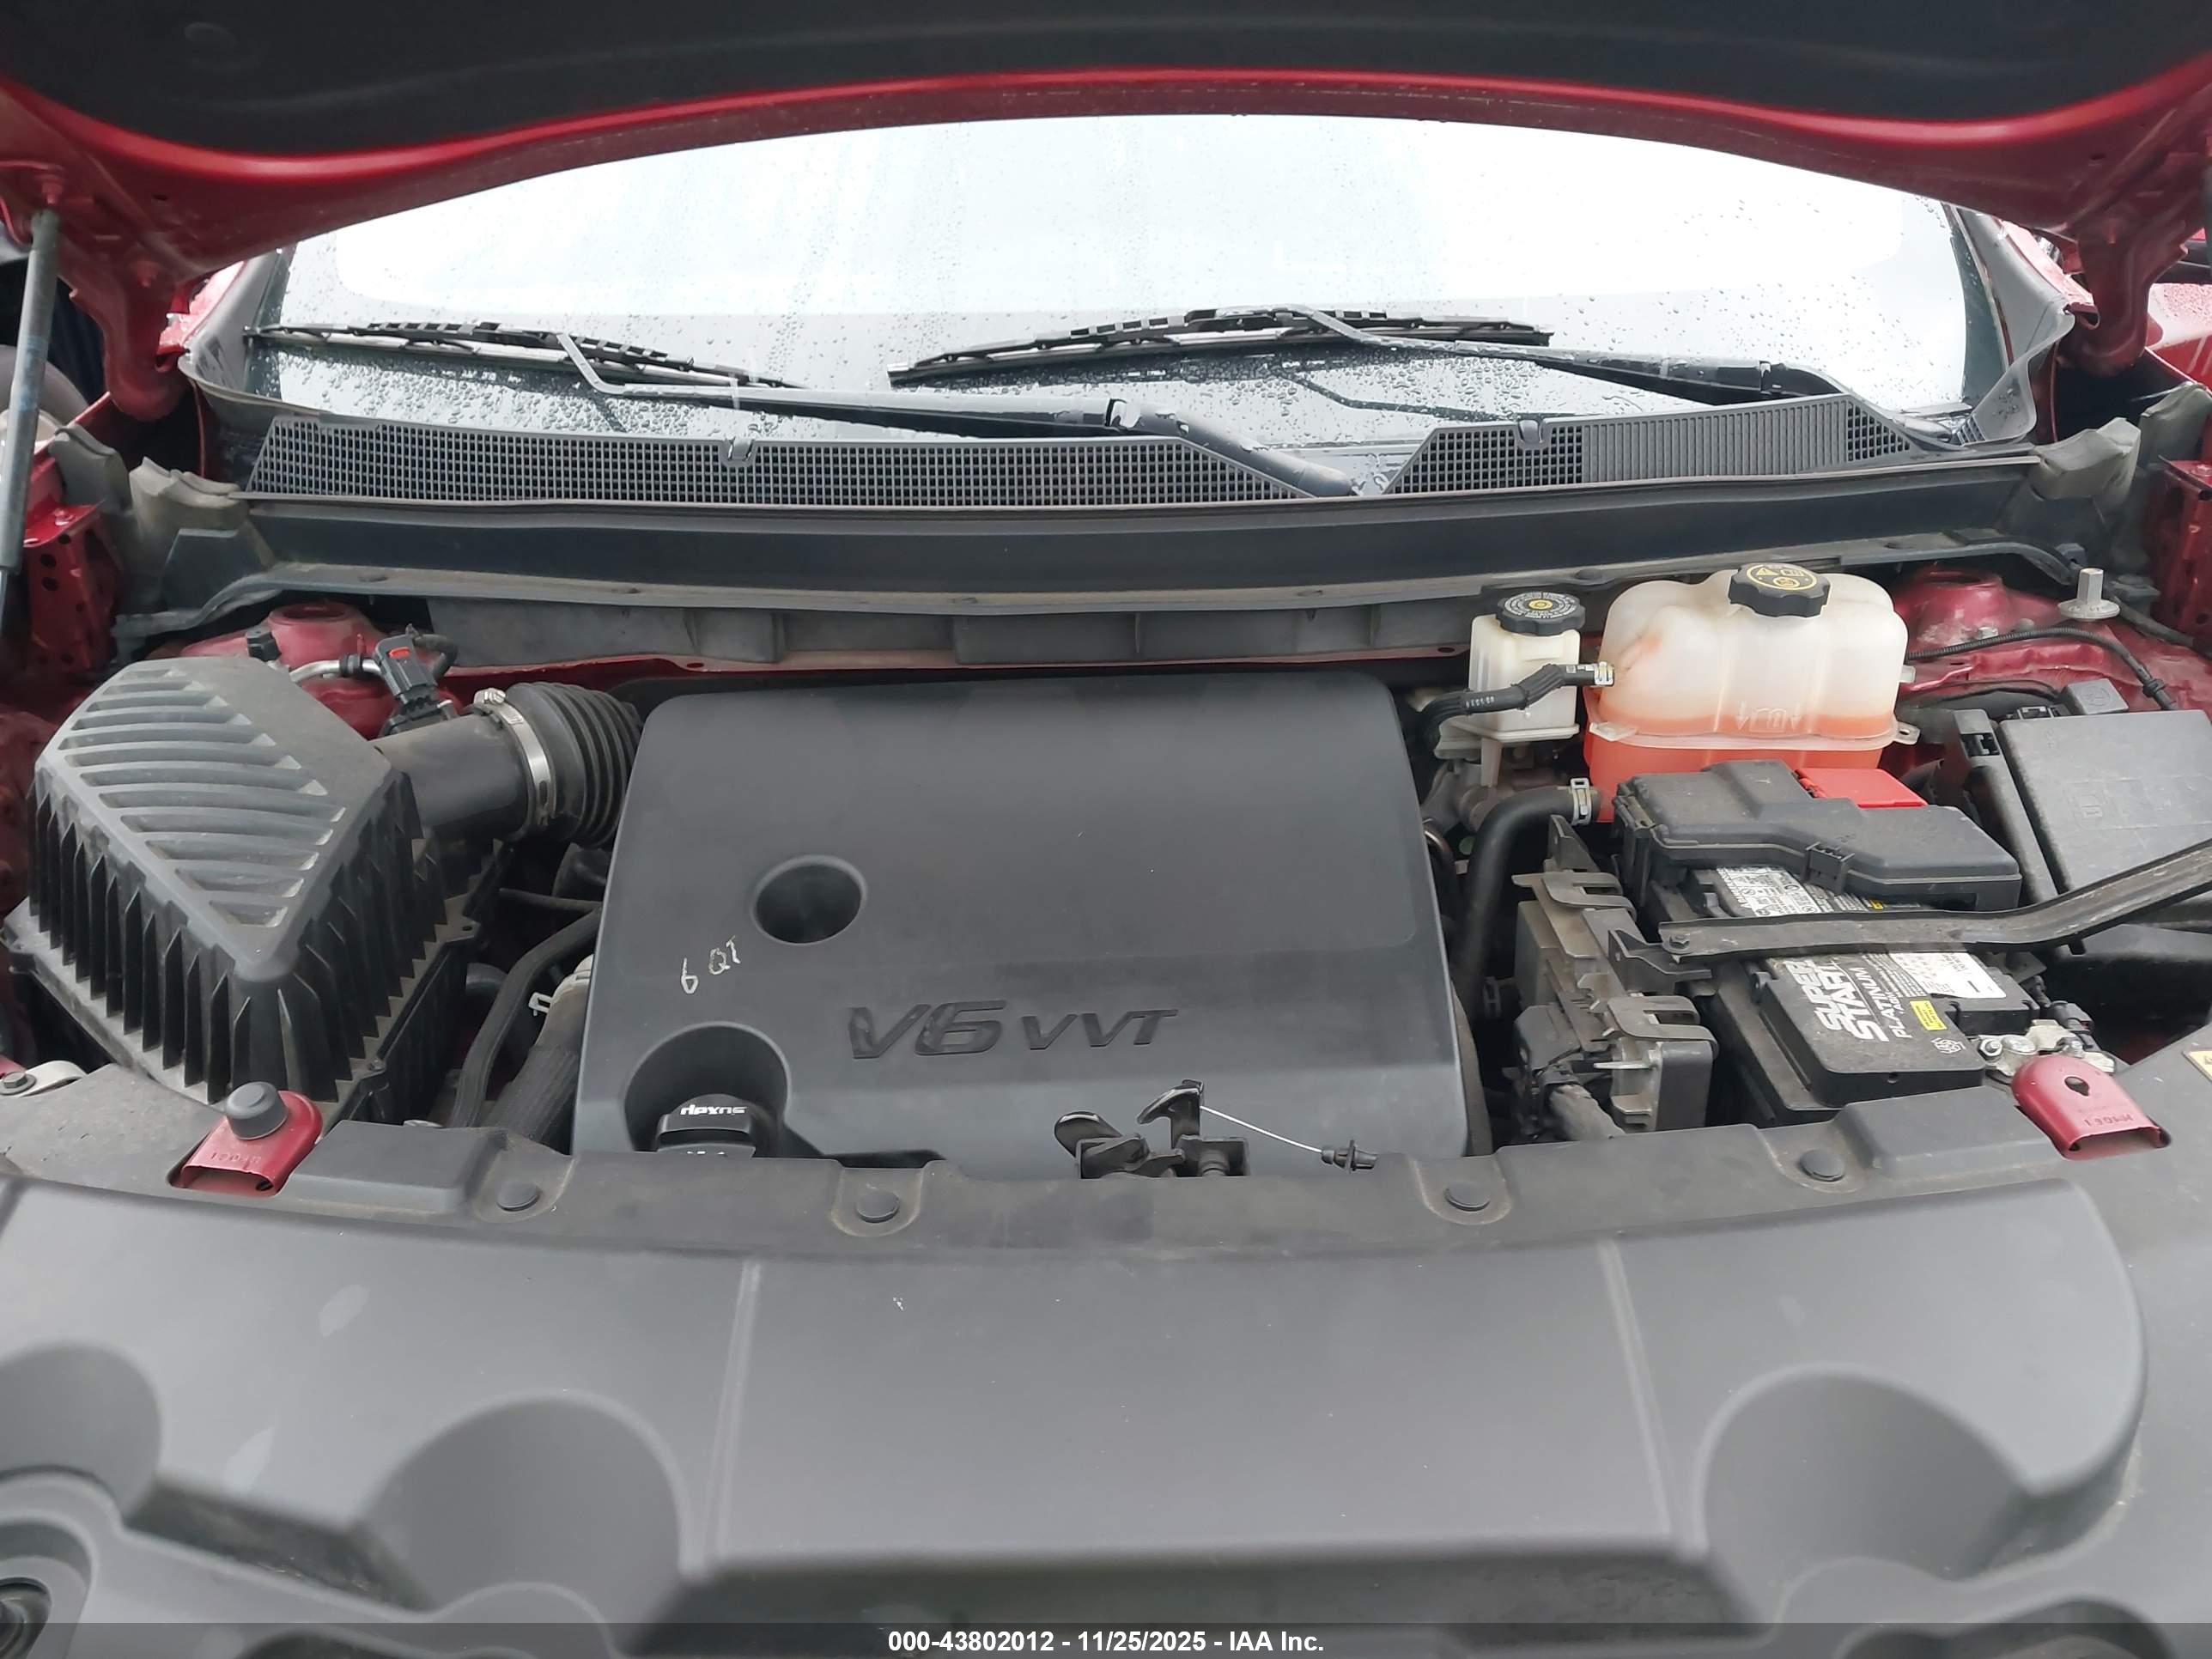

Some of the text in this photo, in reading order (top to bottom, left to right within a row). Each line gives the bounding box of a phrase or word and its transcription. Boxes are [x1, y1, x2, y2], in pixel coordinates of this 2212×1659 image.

[681, 957, 699, 994] 6
[1783, 959, 1844, 1031] SUPER
[1813, 961, 1890, 1042] START
[1849, 967, 1913, 1039] PLATINUM
[1885, 990, 1905, 1011] AGM
[847, 1000, 1180, 1060] V6 VVT
